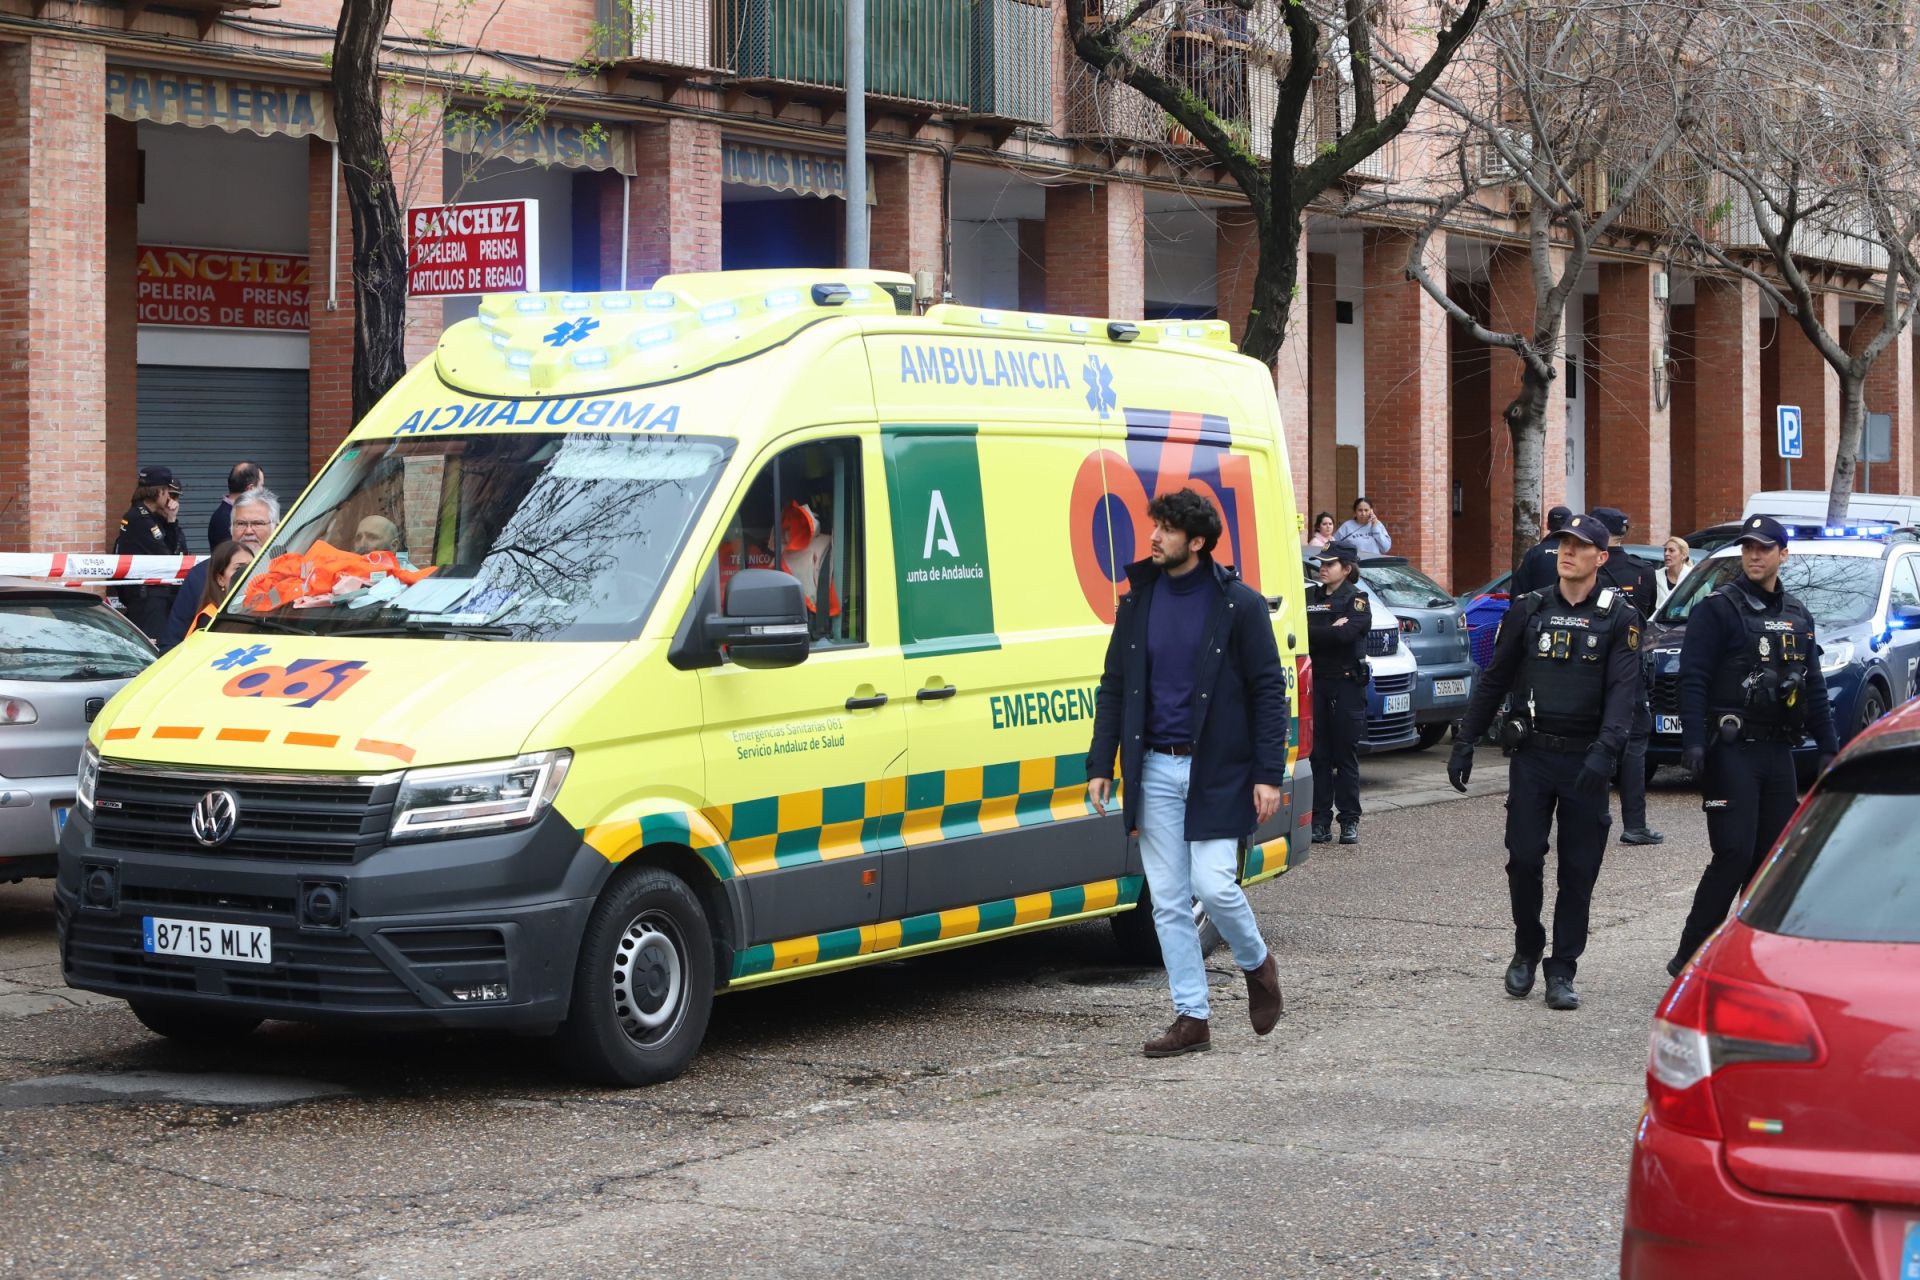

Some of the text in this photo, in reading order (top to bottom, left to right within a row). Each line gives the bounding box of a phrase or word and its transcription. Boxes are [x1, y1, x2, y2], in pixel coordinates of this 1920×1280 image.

[106, 74, 315, 126] PAPELERIA
[415, 206, 520, 238] SANCHEZ
[417, 238, 518, 264] PAPELERIA PRENSA
[412, 265, 523, 291] ARTICULOS DE REGALO
[137, 282, 216, 302] PELERIA
[138, 303, 211, 322] ICULOS
[220, 307, 244, 323] DE
[900, 345, 1071, 390] AMBULANCIA
[1783, 411, 1798, 453] P
[929, 566, 940, 581] de
[941, 562, 984, 580] Andalucía
[222, 660, 371, 701] 061
[732, 718, 843, 743] Emergencias Sanitarias 061
[737, 734, 845, 760] Servicio Andaluz de Salud
[157, 923, 264, 959] 8715 MLK
